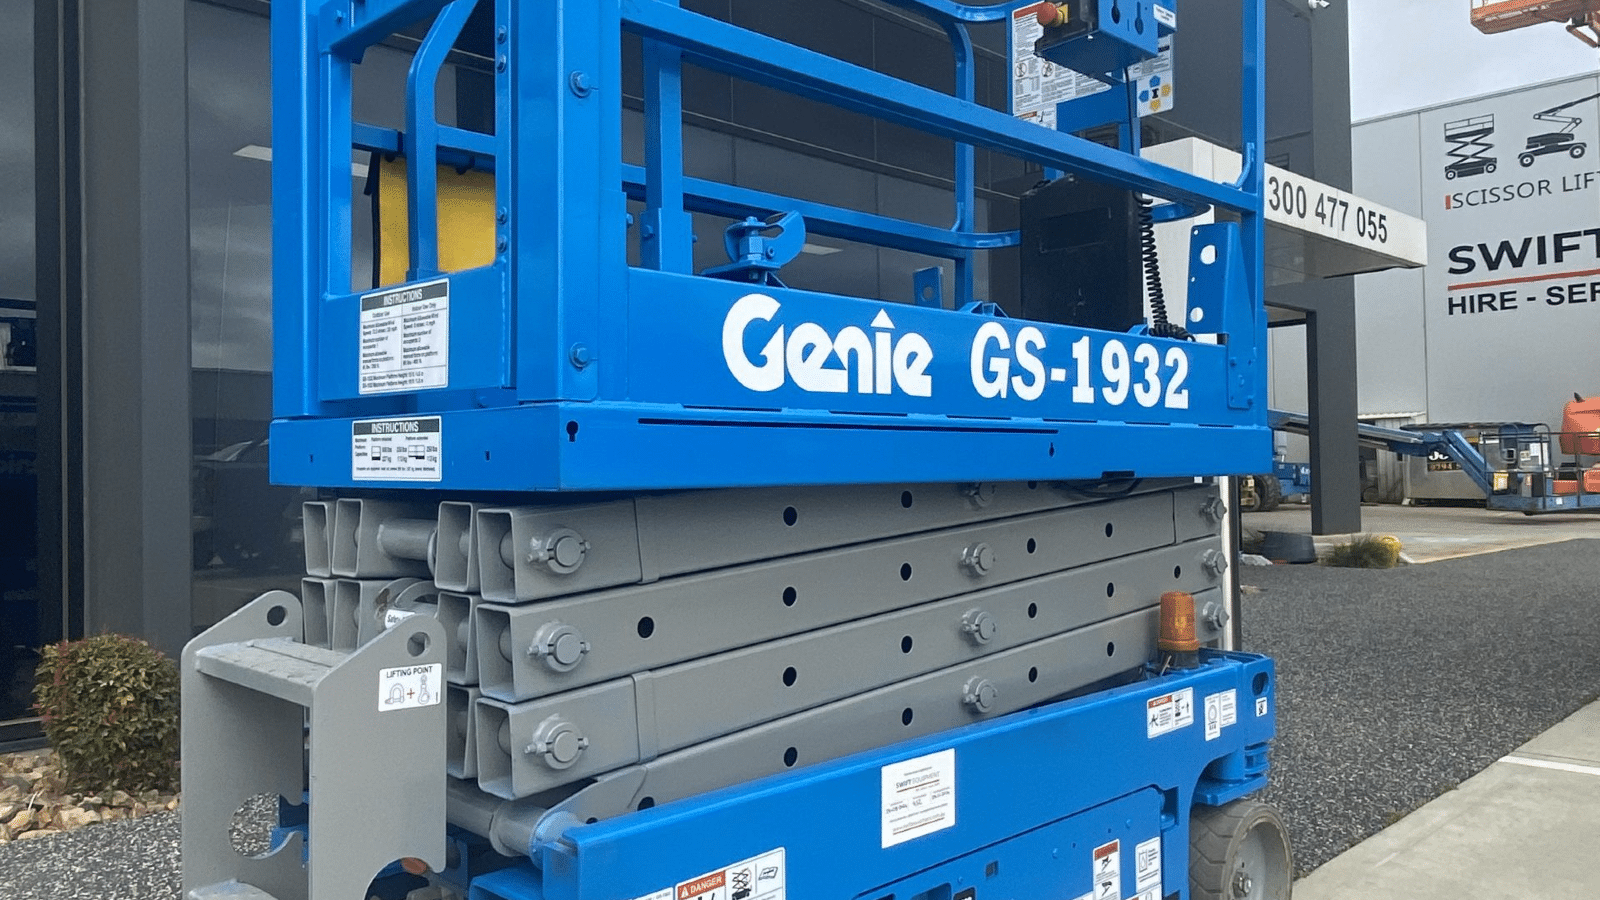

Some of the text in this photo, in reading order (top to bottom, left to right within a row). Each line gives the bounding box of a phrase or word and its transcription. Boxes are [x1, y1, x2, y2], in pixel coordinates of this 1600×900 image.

[1452, 171, 1600, 209] SCISSOR LIF
[1315, 192, 1349, 232] 477
[1356, 206, 1387, 244] 055
[1447, 228, 1600, 275] SWIFT
[383, 288, 423, 306] INSTRUCTIONS
[1448, 290, 1518, 316] HIRE
[722, 293, 1189, 410] Genie GS-1932
[371, 421, 419, 434] INSTRUCTIONS
[386, 665, 433, 679] LIFTING POINT
[690, 875, 722, 894] DANGER
